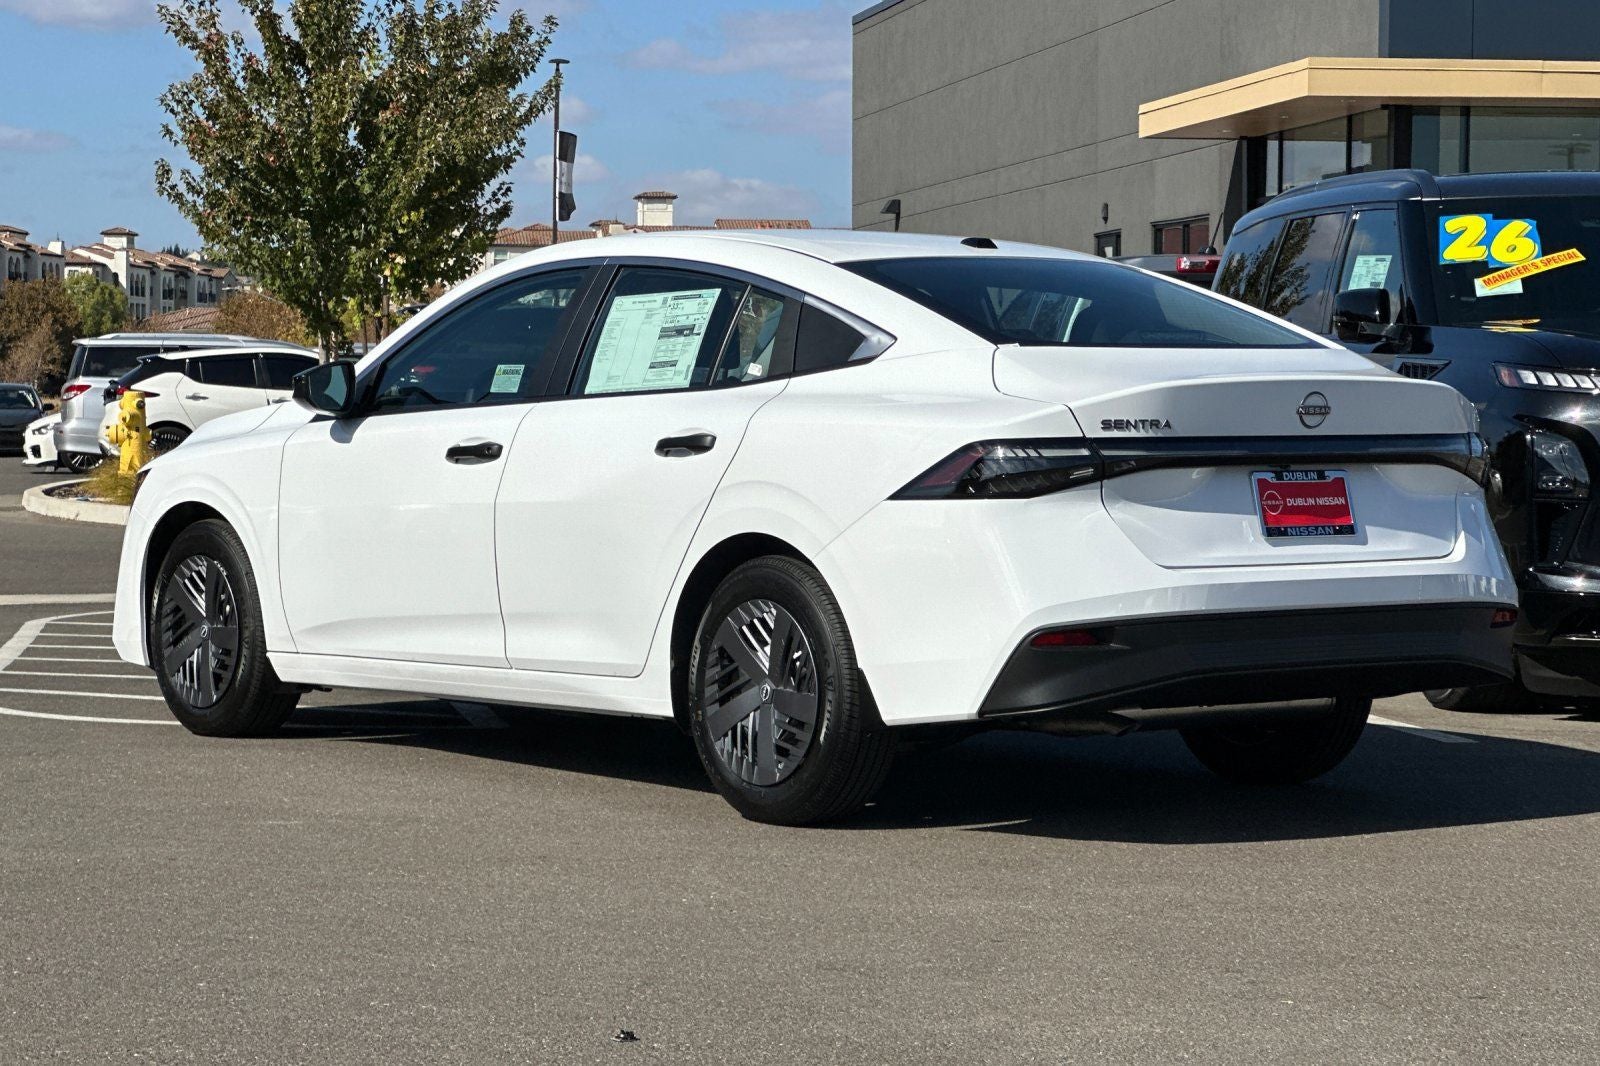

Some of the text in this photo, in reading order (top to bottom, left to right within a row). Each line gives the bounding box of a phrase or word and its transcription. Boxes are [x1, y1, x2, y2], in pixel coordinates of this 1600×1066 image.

[1442, 215, 1538, 264] 26
[1482, 250, 1580, 287] MANAGER'S SPECIAL
[1298, 406, 1330, 415] NISSAN
[1100, 419, 1172, 430] SENTRA
[1283, 471, 1318, 480] DUBLIN
[1286, 497, 1345, 506] DUBLIN NISSAN
[1287, 526, 1334, 536] NISSAN
